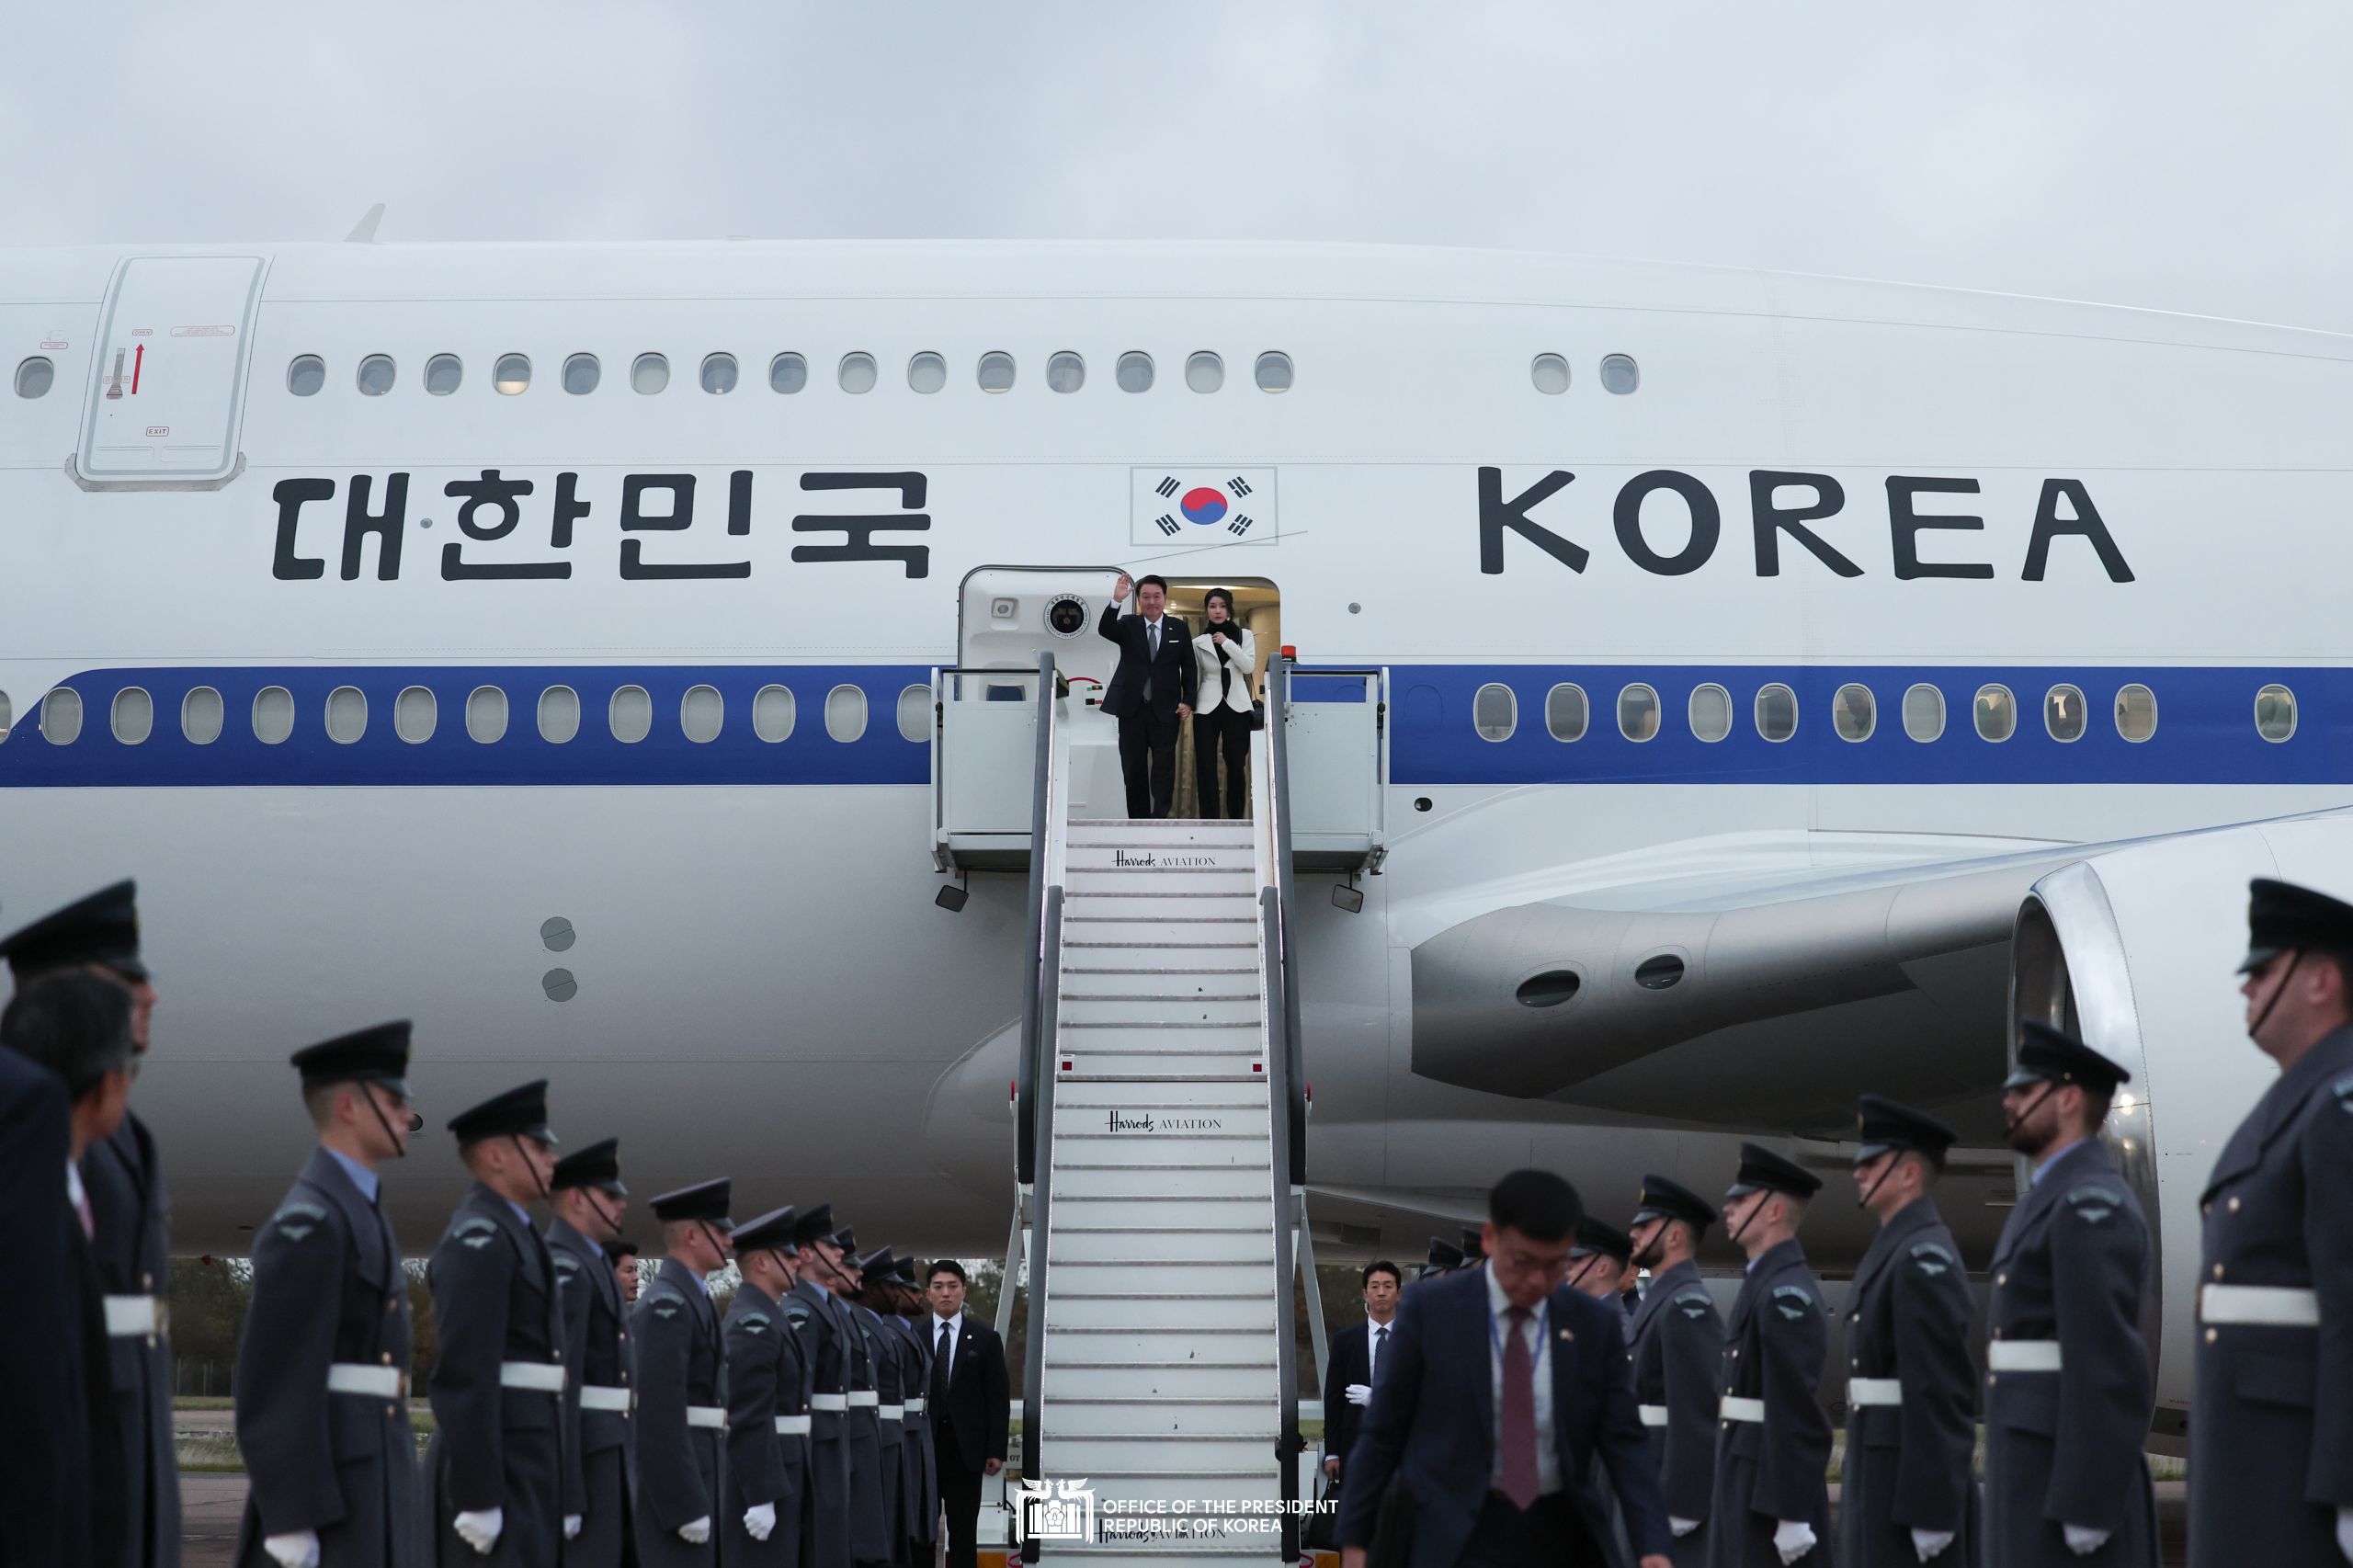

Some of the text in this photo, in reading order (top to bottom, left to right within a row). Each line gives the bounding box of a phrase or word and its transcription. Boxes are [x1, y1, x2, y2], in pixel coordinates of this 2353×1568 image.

[273, 470, 931, 582] 대한민국
[1478, 467, 2135, 584] KOREA
[1111, 850, 1216, 867] Harrods AVIATION
[1104, 1110, 1222, 1132] Harrods AVIATION
